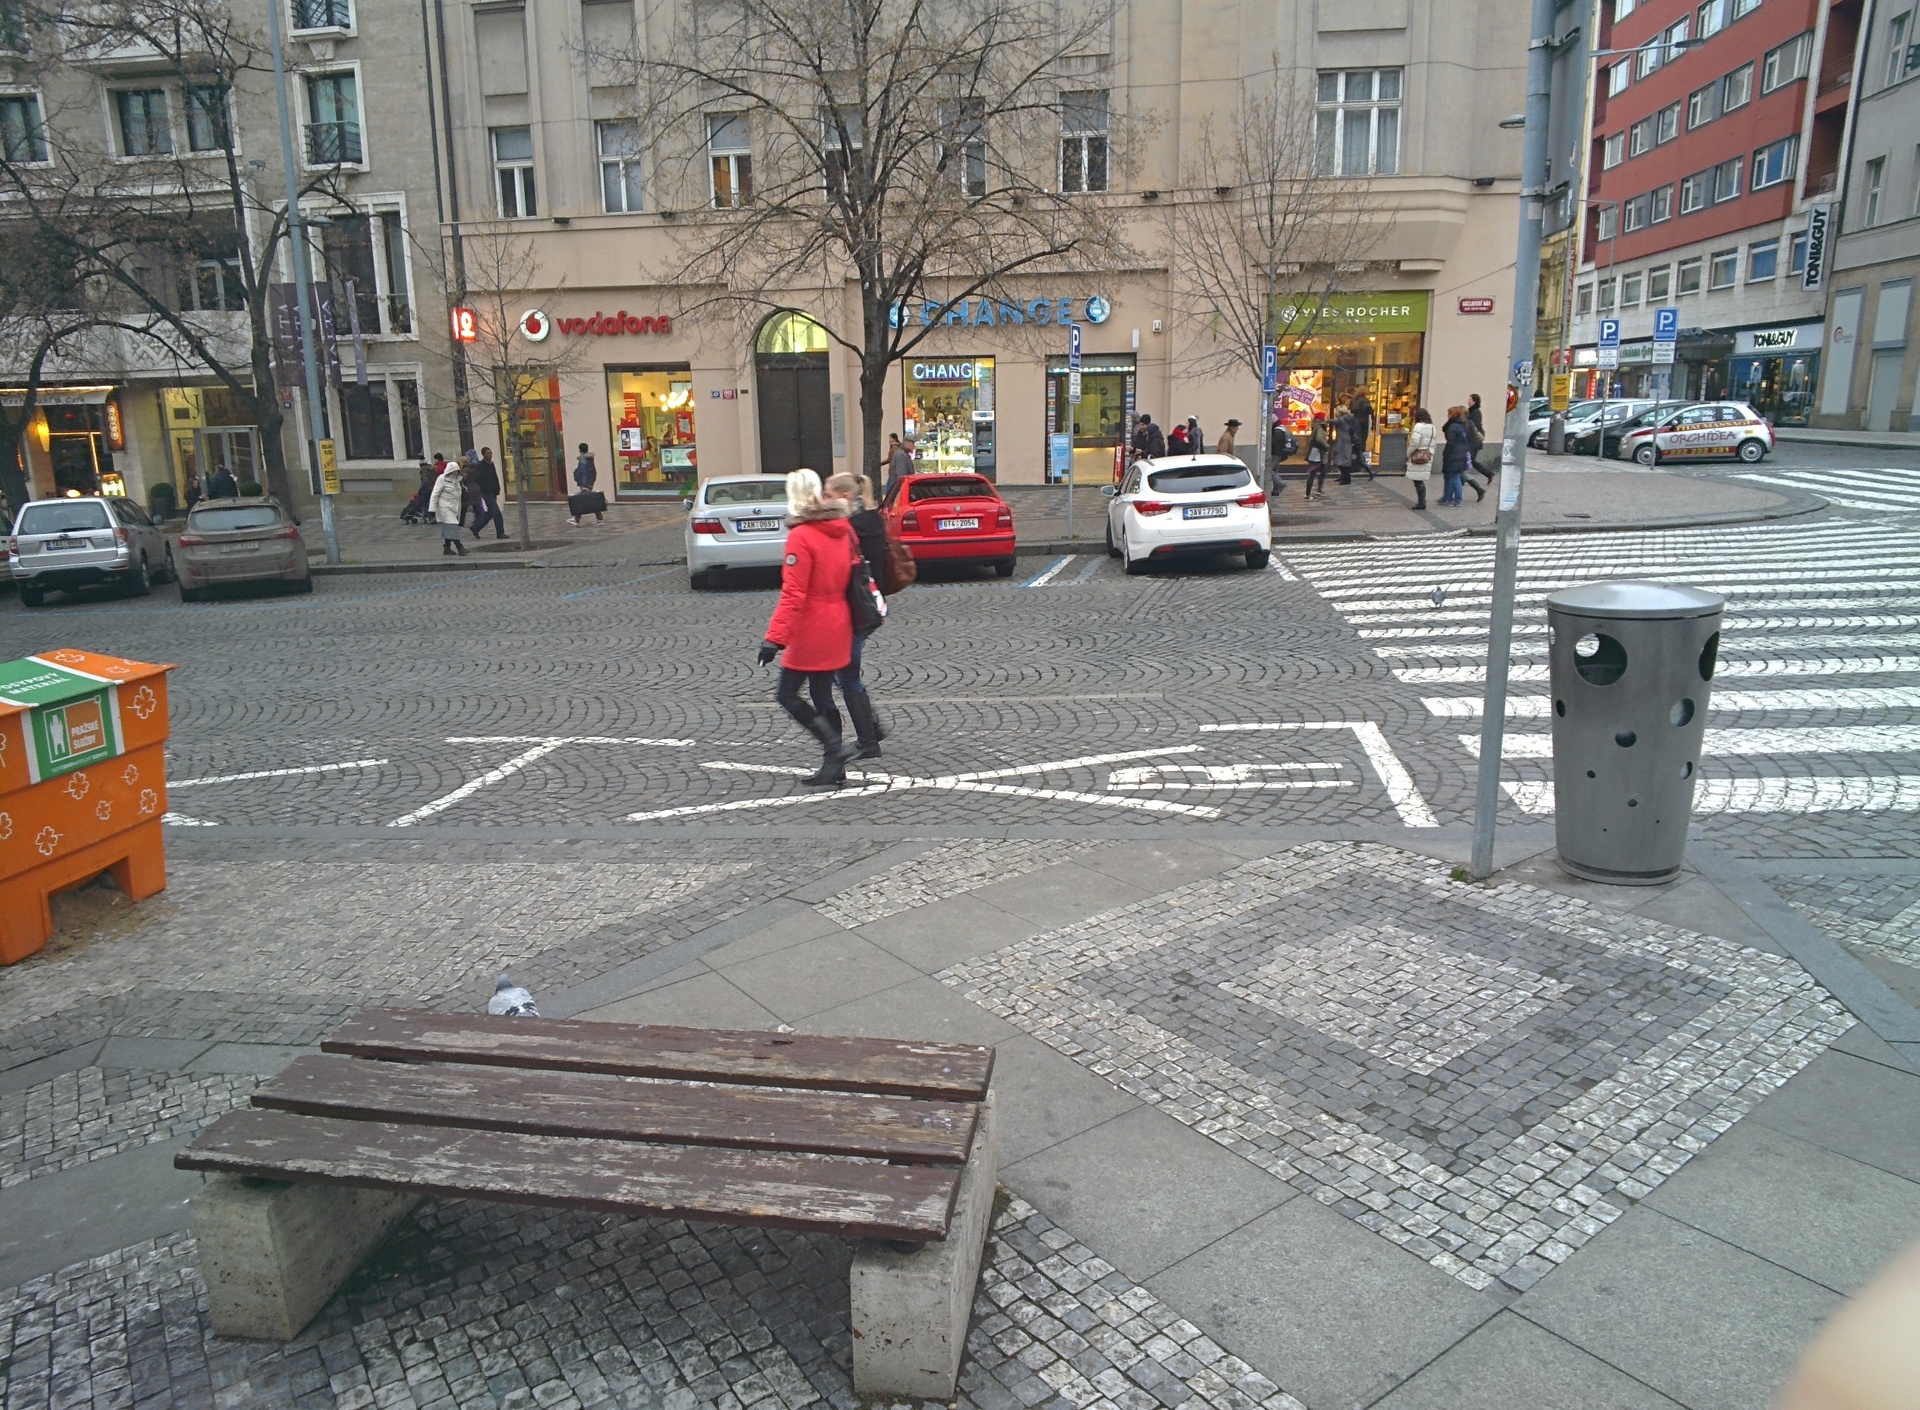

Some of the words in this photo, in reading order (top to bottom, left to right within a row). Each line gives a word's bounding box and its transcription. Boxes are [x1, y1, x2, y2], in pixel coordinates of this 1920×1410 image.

[1806, 208, 1827, 287] TONI&GUY
[920, 297, 1074, 328] CHANGE
[1346, 306, 1410, 317] ROCHER
[557, 311, 672, 335] vodafone
[1603, 322, 1616, 339] P
[1659, 312, 1673, 331] P
[1072, 329, 1080, 354] P
[1753, 329, 1796, 348] TONI&GUY
[913, 363, 983, 379] CHANGE
[1266, 351, 1274, 377] P
[1703, 420, 1753, 430] MASSAGE
[1669, 430, 1737, 444] ORCHIDEA
